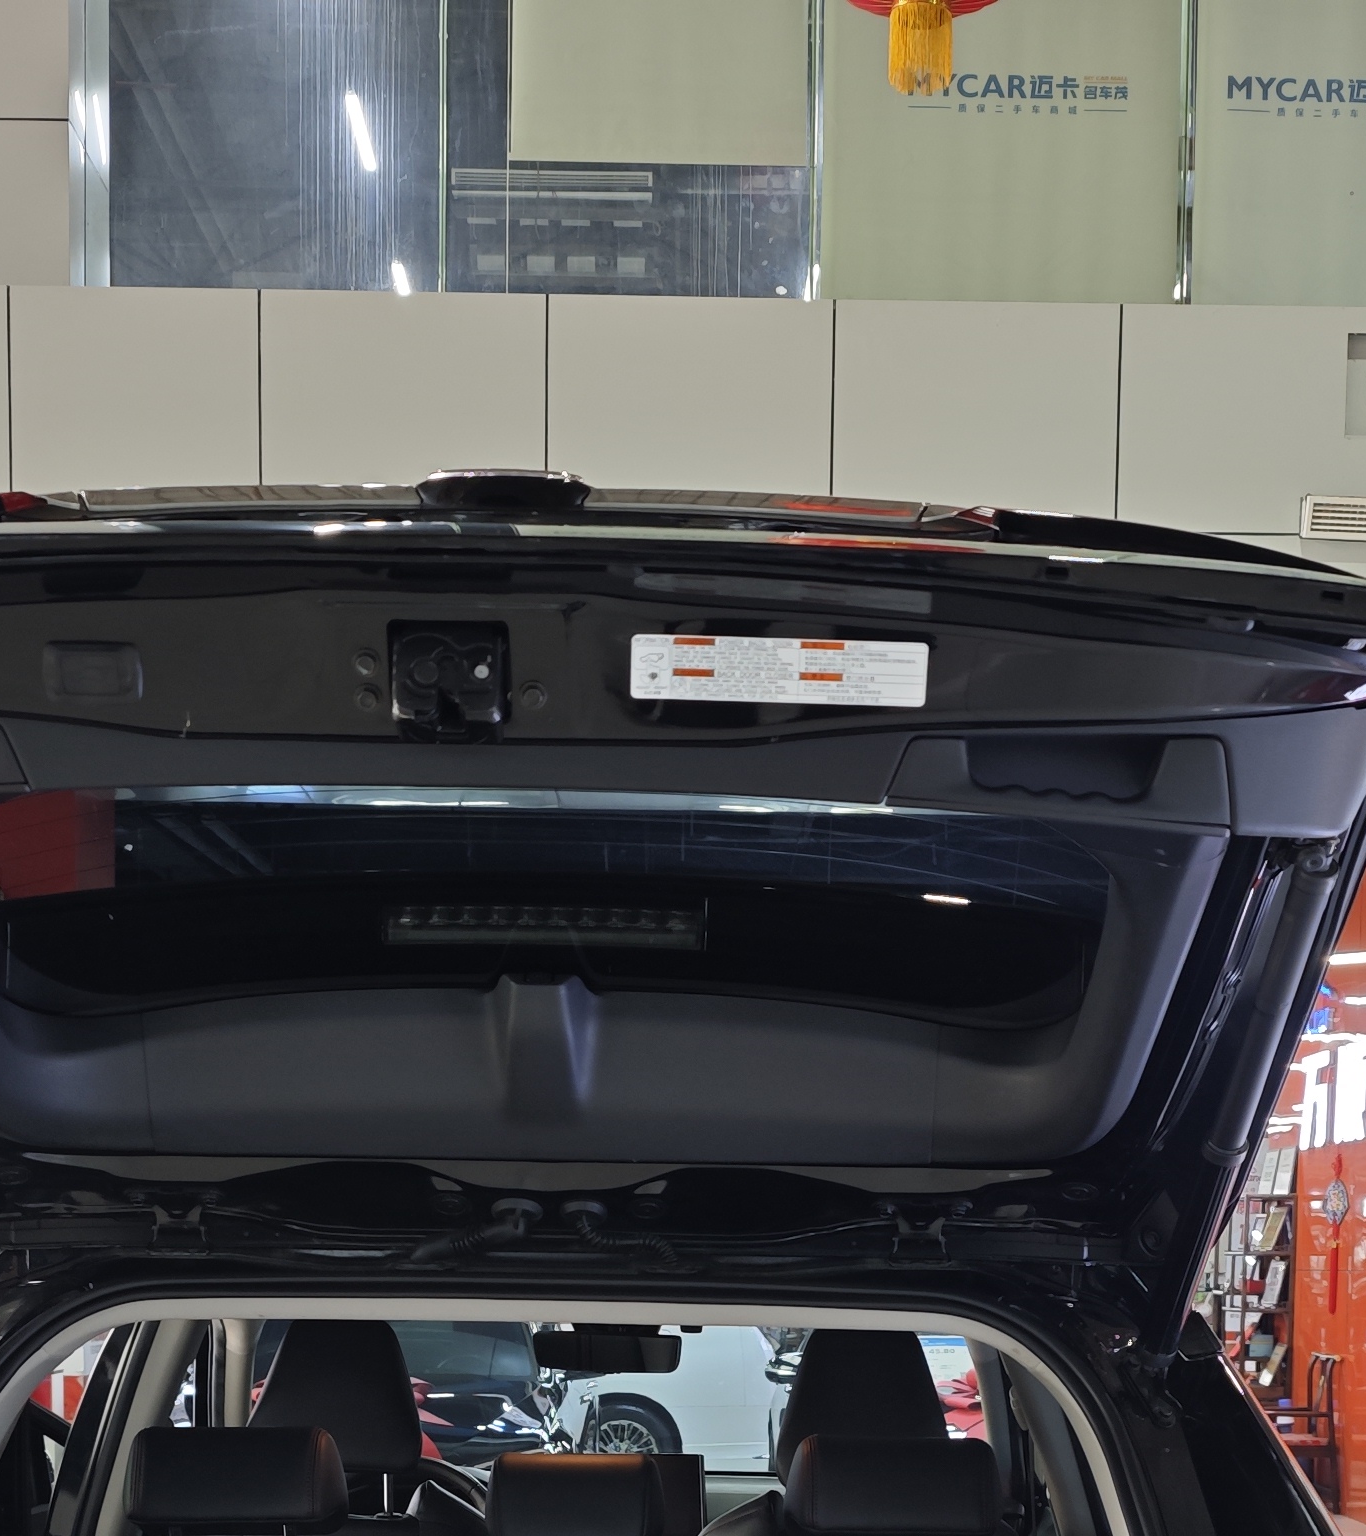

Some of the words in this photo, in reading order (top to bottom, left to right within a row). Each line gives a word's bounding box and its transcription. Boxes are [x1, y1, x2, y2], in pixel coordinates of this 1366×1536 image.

[957, 103, 1078, 116] 质保二手车商城
